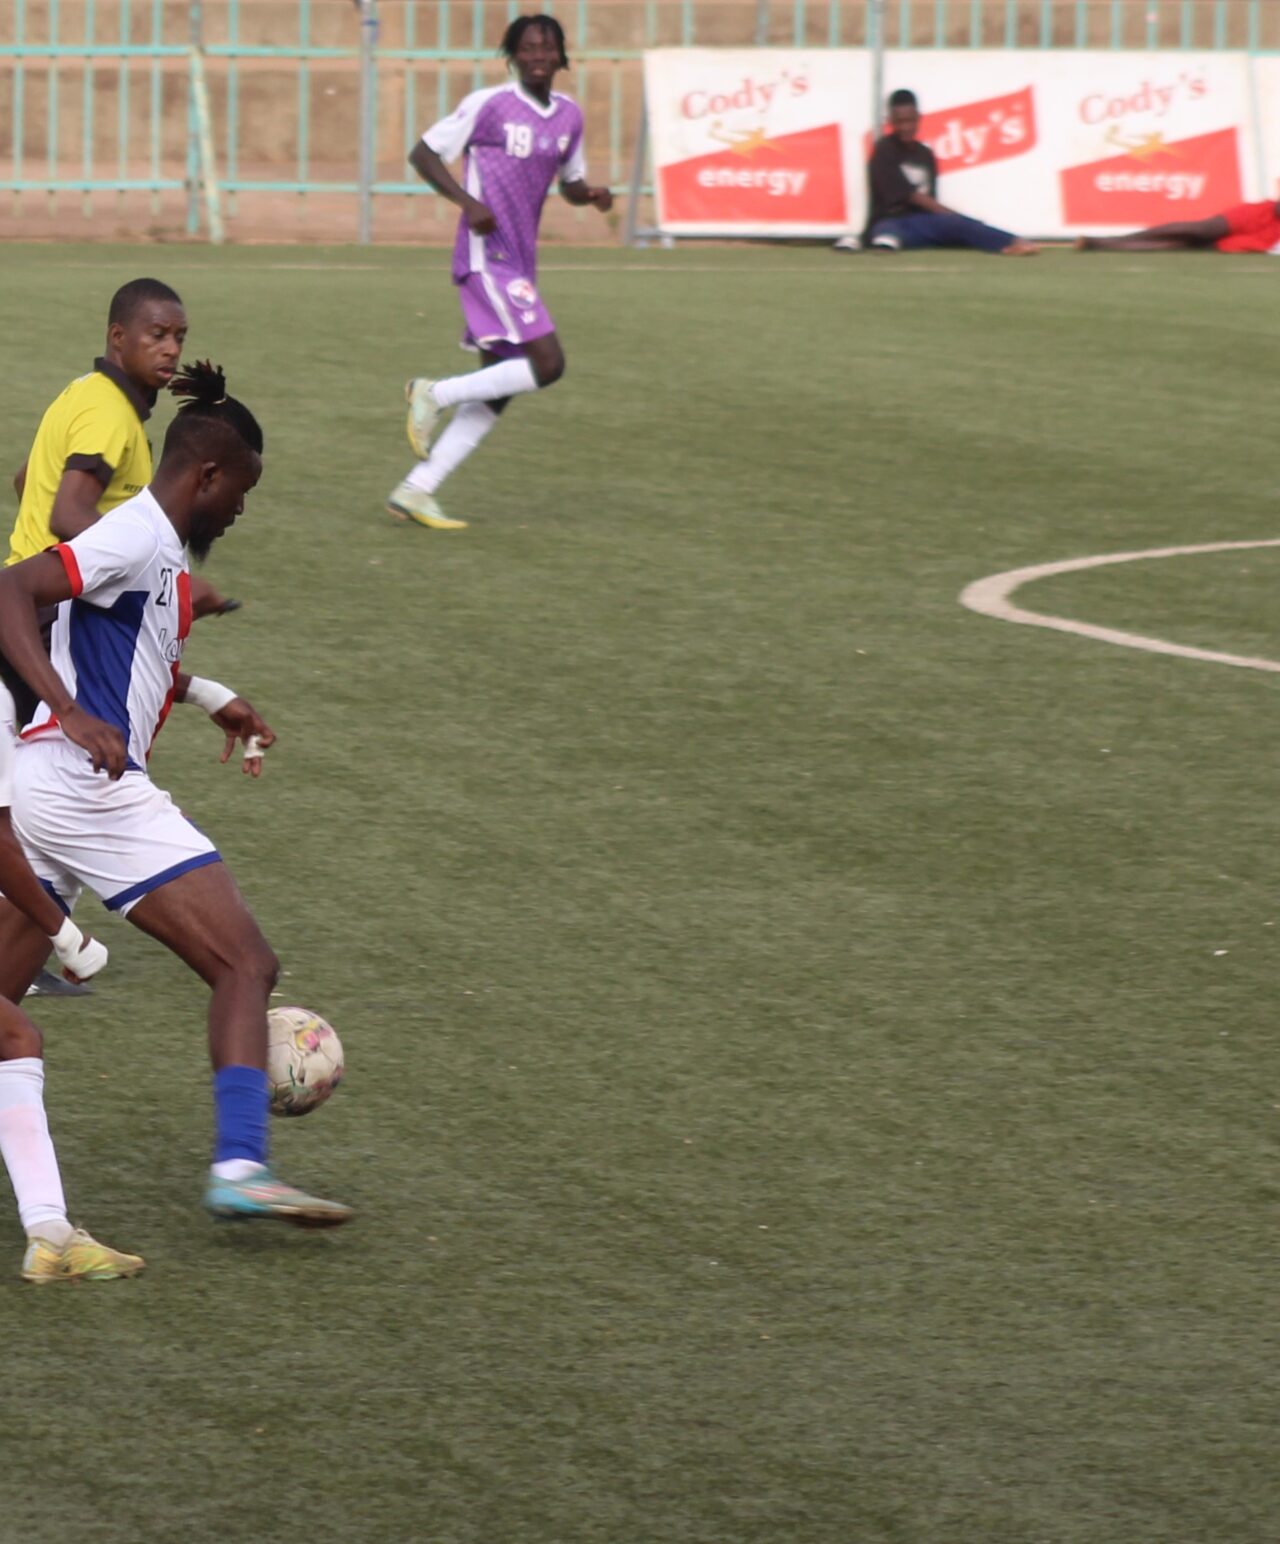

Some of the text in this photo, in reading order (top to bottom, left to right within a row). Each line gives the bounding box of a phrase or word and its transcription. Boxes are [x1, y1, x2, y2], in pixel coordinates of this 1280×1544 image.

[680, 70, 810, 119] Cody's
[1079, 72, 1206, 125] Cody's
[503, 122, 533, 159] 19
[934, 110, 1025, 165] dy's
[696, 168, 809, 196] energy
[1094, 173, 1206, 200] energy
[155, 568, 173, 607] 27
